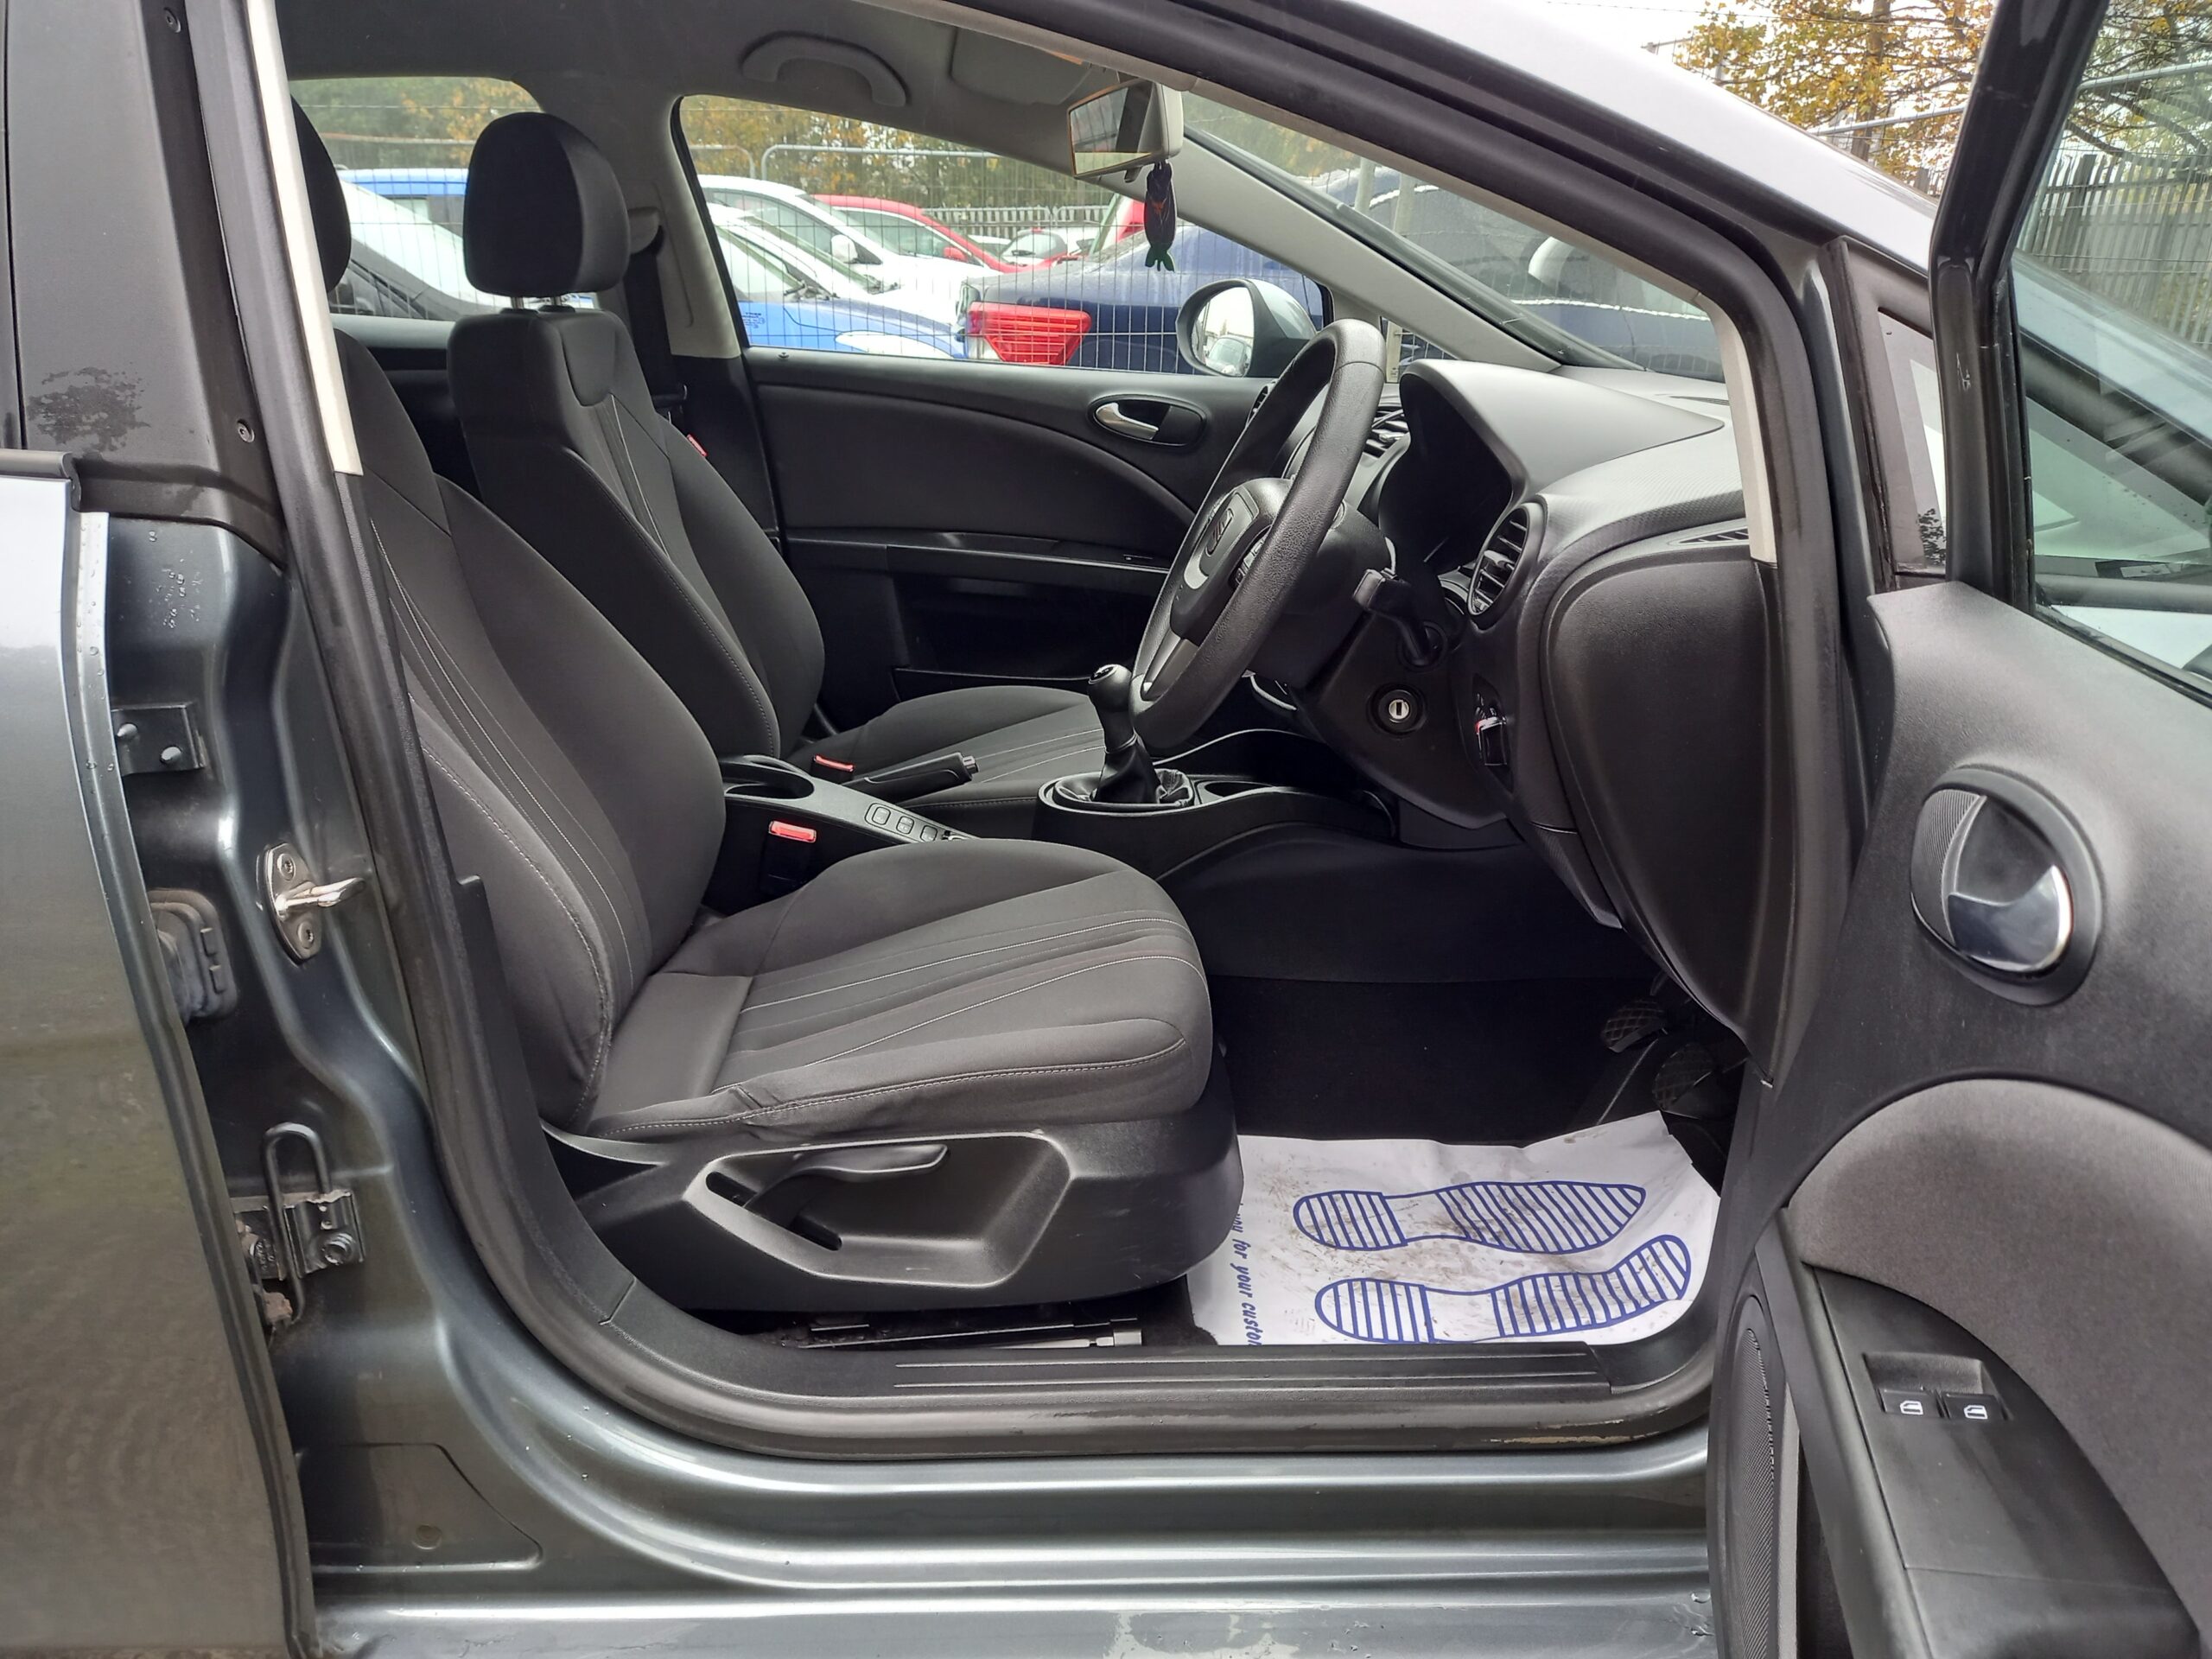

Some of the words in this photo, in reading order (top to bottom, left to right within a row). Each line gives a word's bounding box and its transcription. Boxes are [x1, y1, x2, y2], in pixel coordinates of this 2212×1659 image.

[1231, 1214, 1243, 1233] ou
[1232, 1238, 1251, 1259] for
[1230, 1262, 1253, 1298] your
